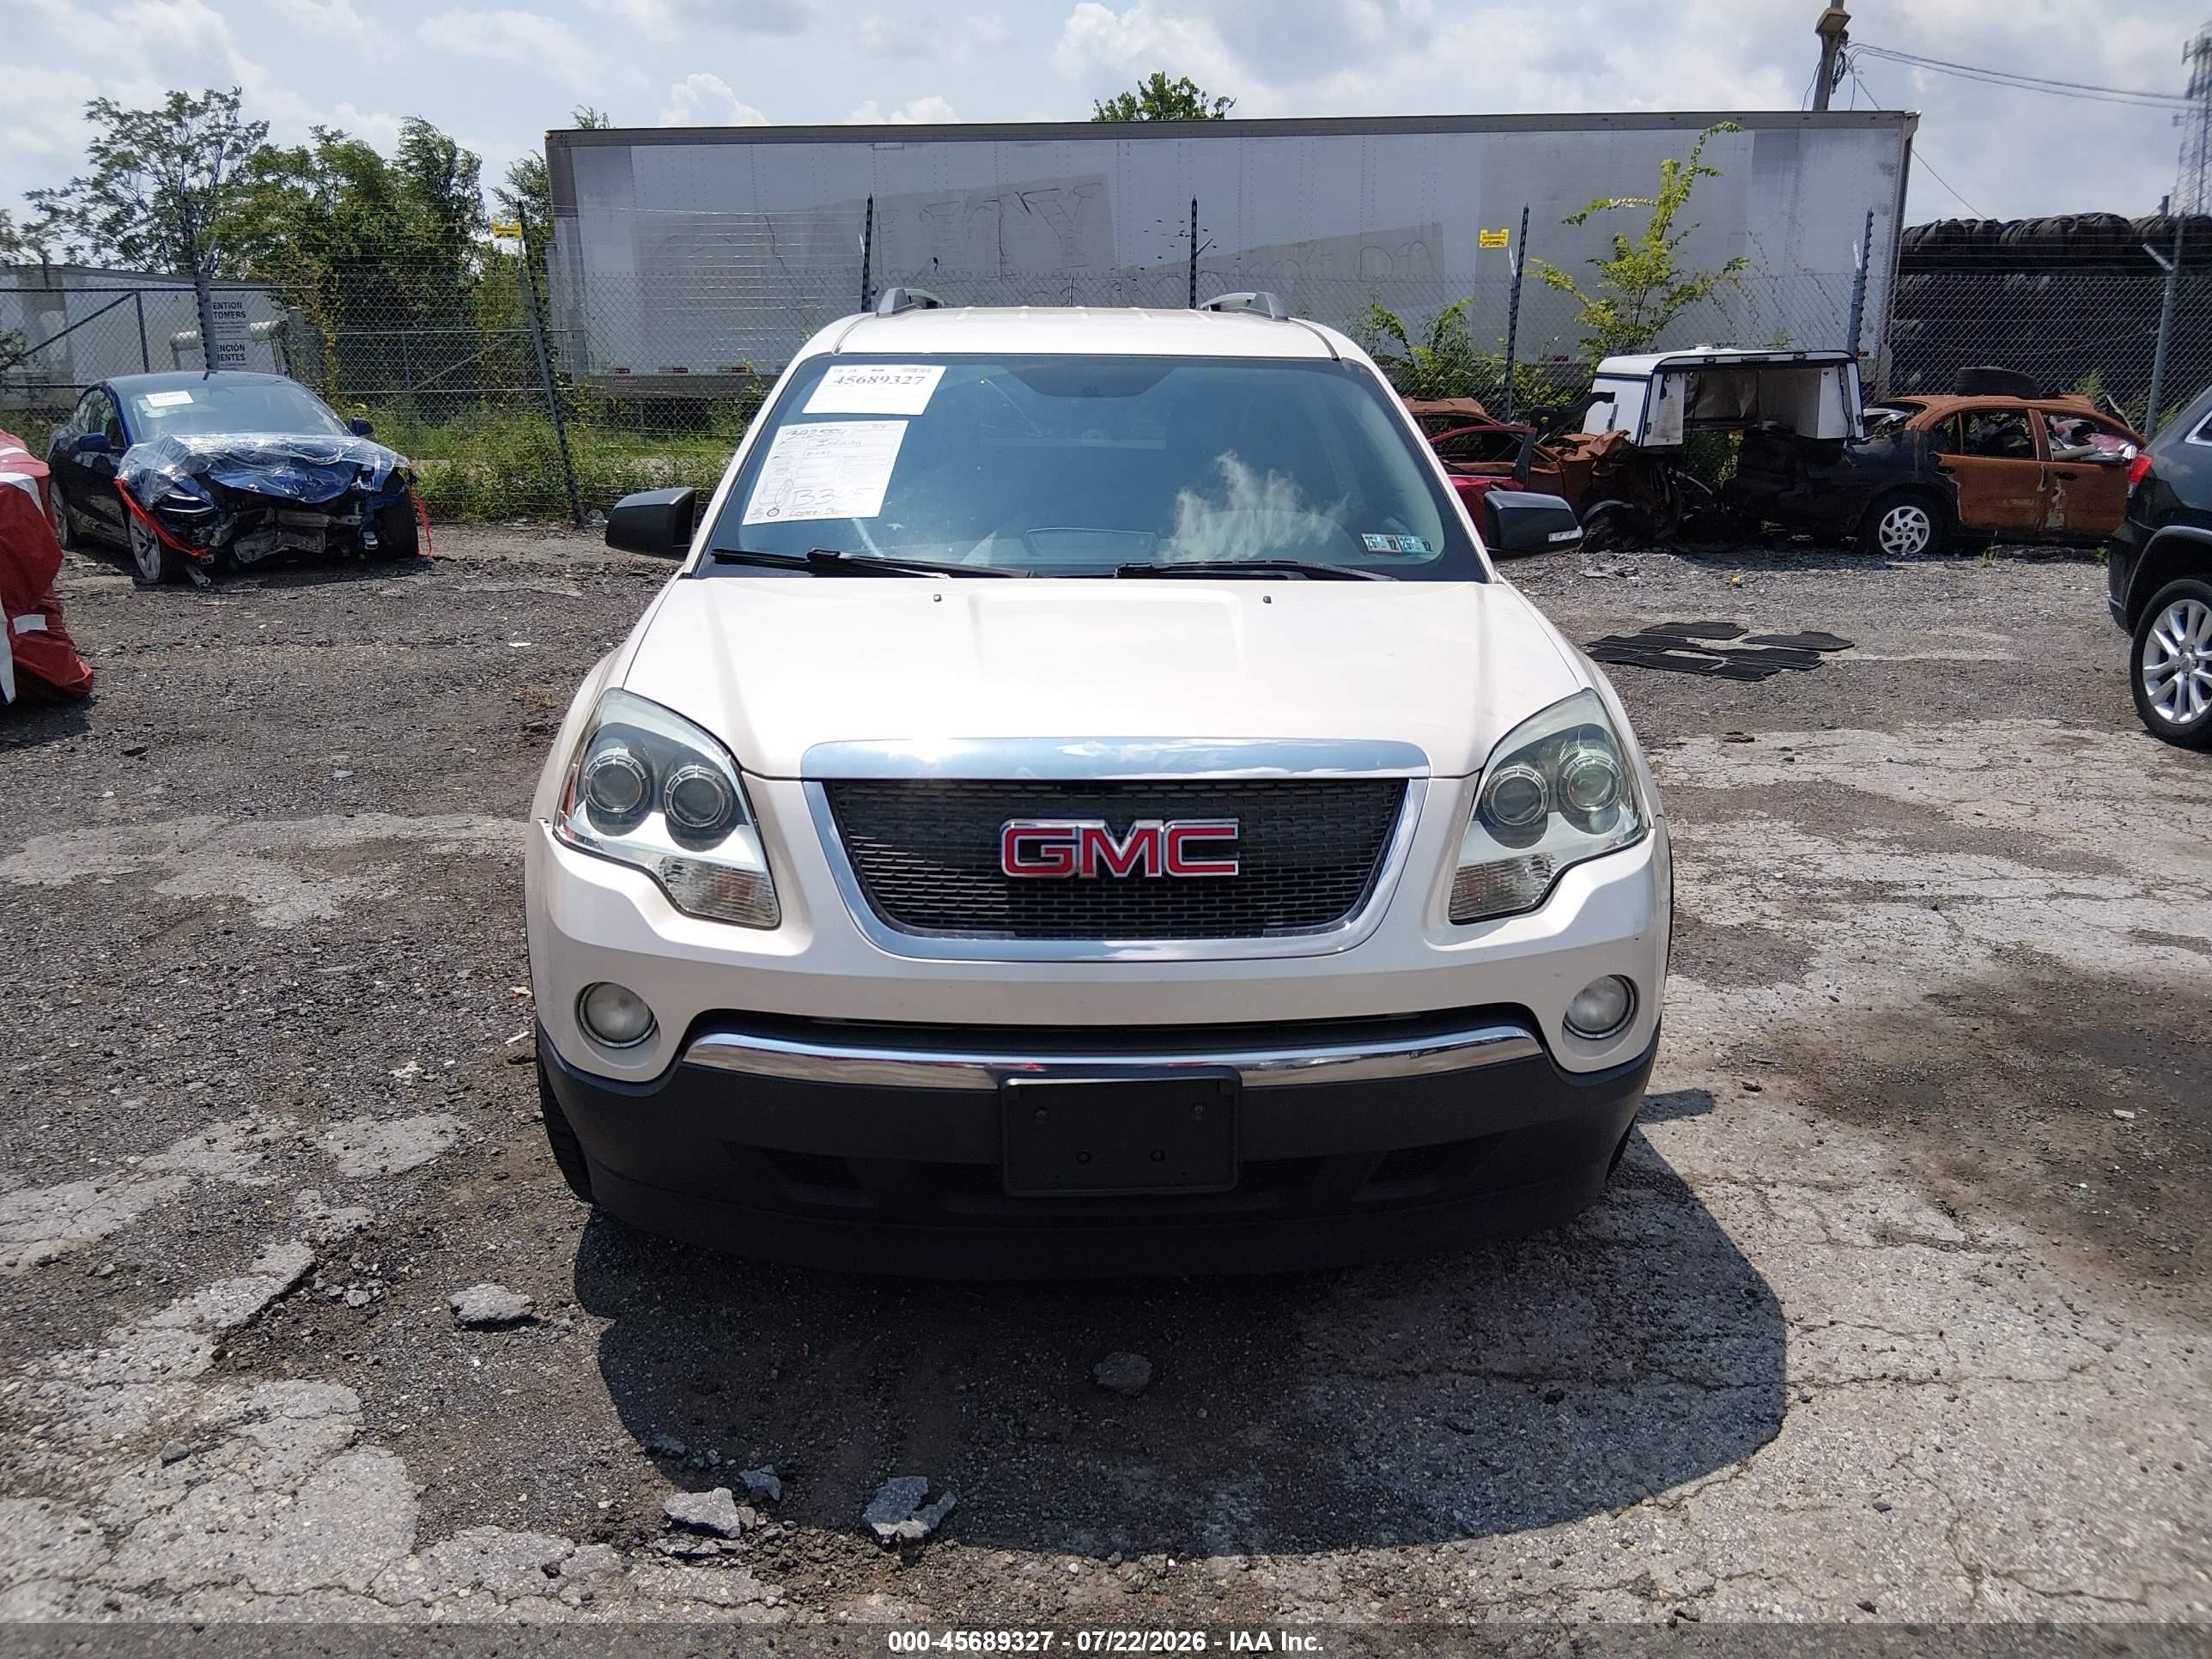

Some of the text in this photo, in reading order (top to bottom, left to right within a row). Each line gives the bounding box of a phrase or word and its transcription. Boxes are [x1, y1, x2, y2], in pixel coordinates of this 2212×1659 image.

[216, 343, 246, 352] ENCIÓN
[832, 375, 926, 385] 45689327
[1000, 819, 1240, 878] GMC
